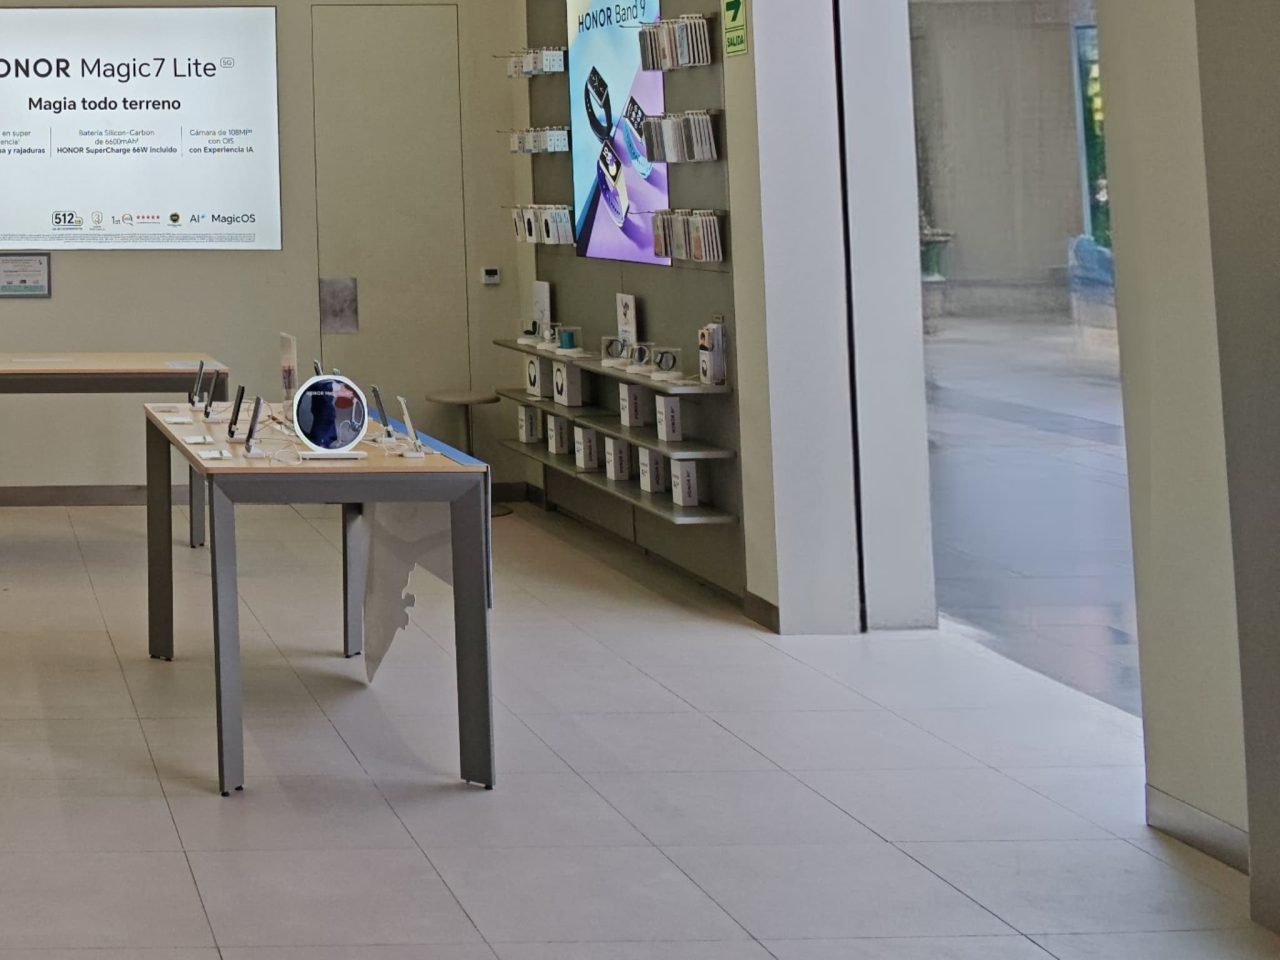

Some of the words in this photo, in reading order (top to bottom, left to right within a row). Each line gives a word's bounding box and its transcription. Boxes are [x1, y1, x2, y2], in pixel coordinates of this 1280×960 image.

[578, 7, 612, 33] HONOR
[615, 0, 638, 24] Band
[726, 35, 745, 48] SALIDA
[81, 57, 165, 83] Magic7
[173, 57, 217, 78] Lite
[28, 97, 76, 114] Magia
[81, 96, 118, 111] todo
[122, 98, 181, 111] terreno
[13, 147, 46, 155] rajaduras
[85, 146, 131, 155] SuperCharge
[203, 146, 245, 154] Experiencia
[54, 212, 74, 225] 512
[211, 214, 256, 225] MagicOS
